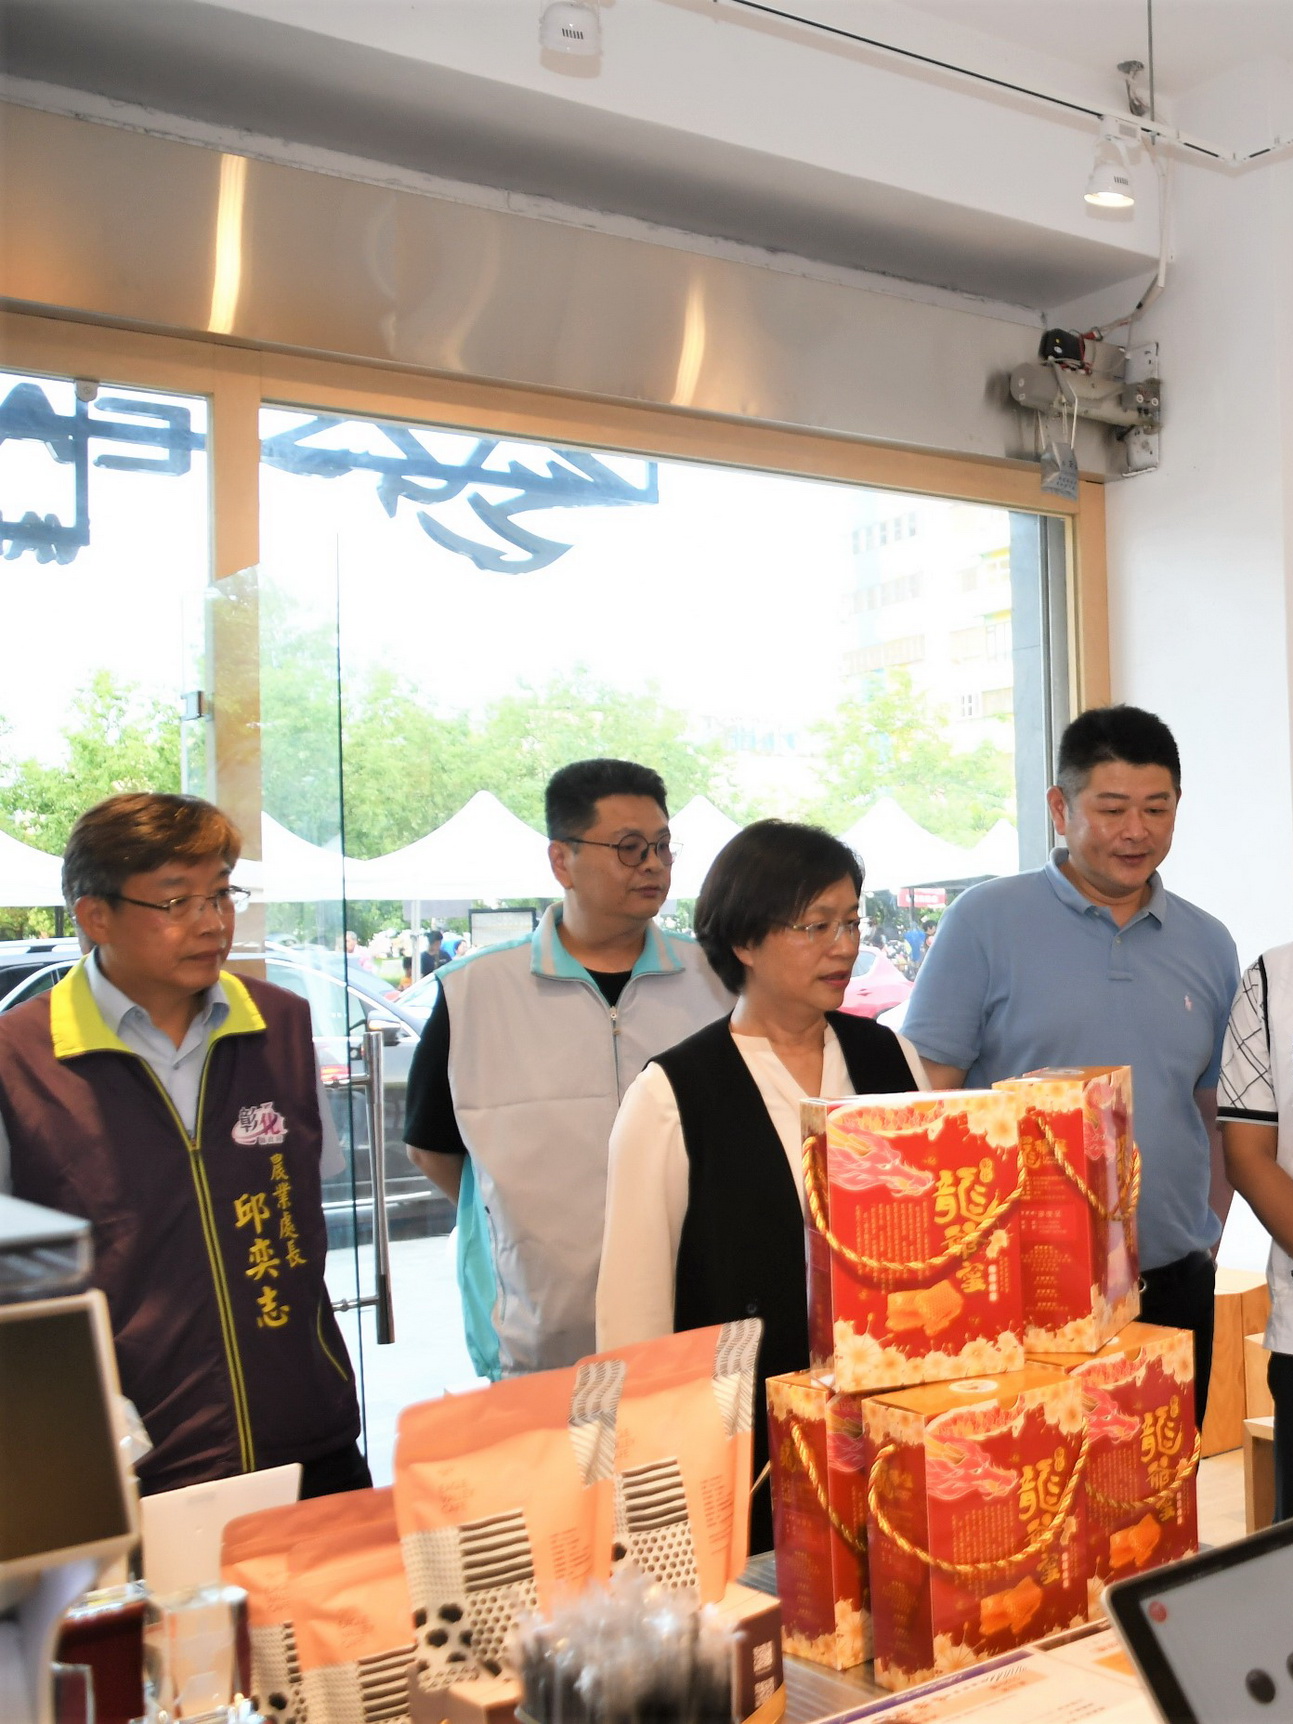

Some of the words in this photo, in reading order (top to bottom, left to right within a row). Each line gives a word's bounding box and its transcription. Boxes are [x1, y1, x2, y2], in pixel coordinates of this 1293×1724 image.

[233, 1192, 291, 1329] 邱奕志
[269, 1152, 308, 1269] 農業處長
